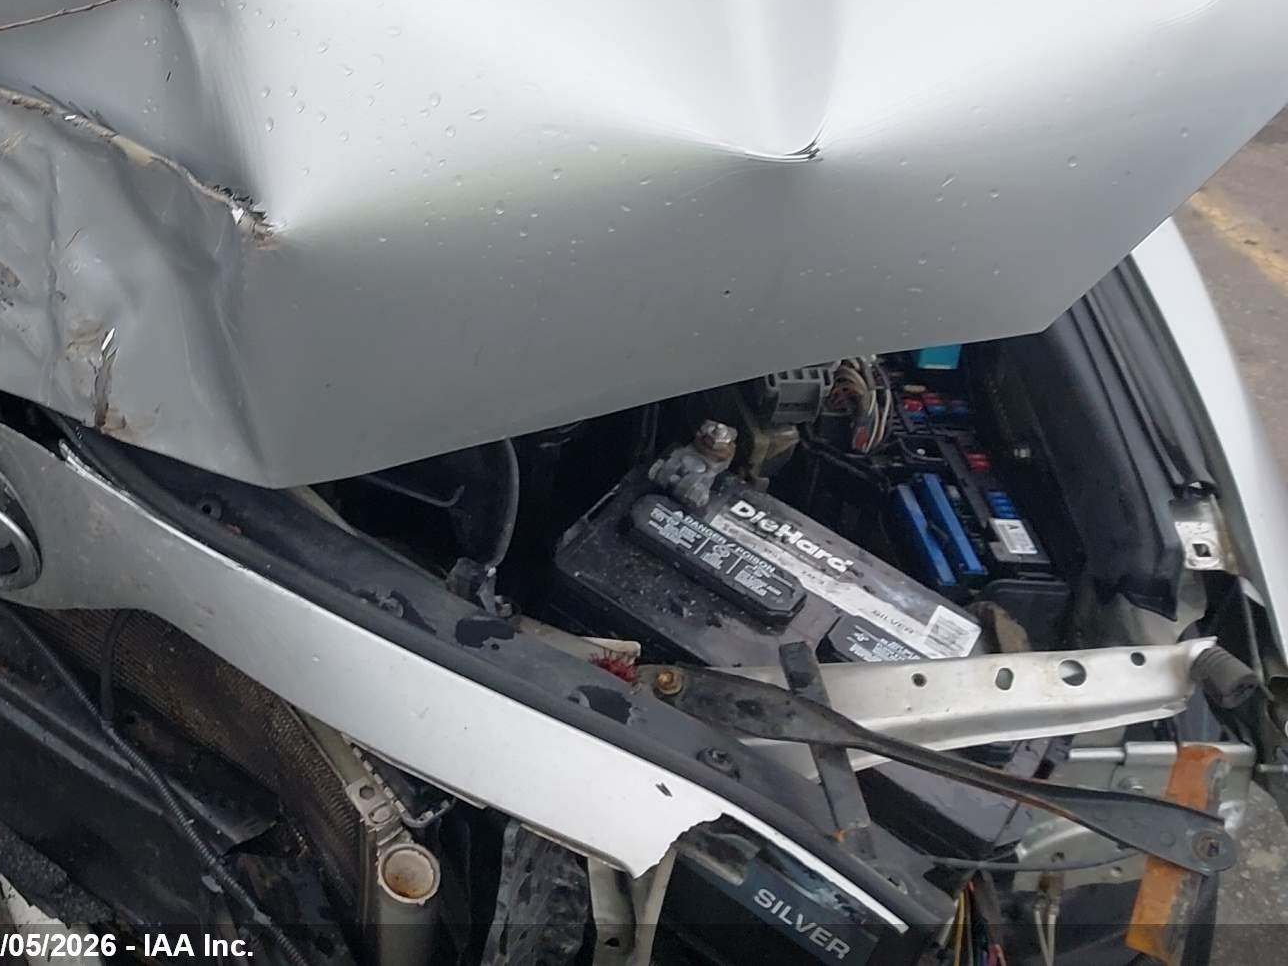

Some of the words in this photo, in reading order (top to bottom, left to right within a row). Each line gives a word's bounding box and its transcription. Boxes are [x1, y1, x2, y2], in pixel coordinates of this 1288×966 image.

[683, 515, 727, 546] DANGER
[735, 546, 776, 574] POISON
[730, 499, 855, 573] DieHard
[753, 888, 851, 960] SILVER
